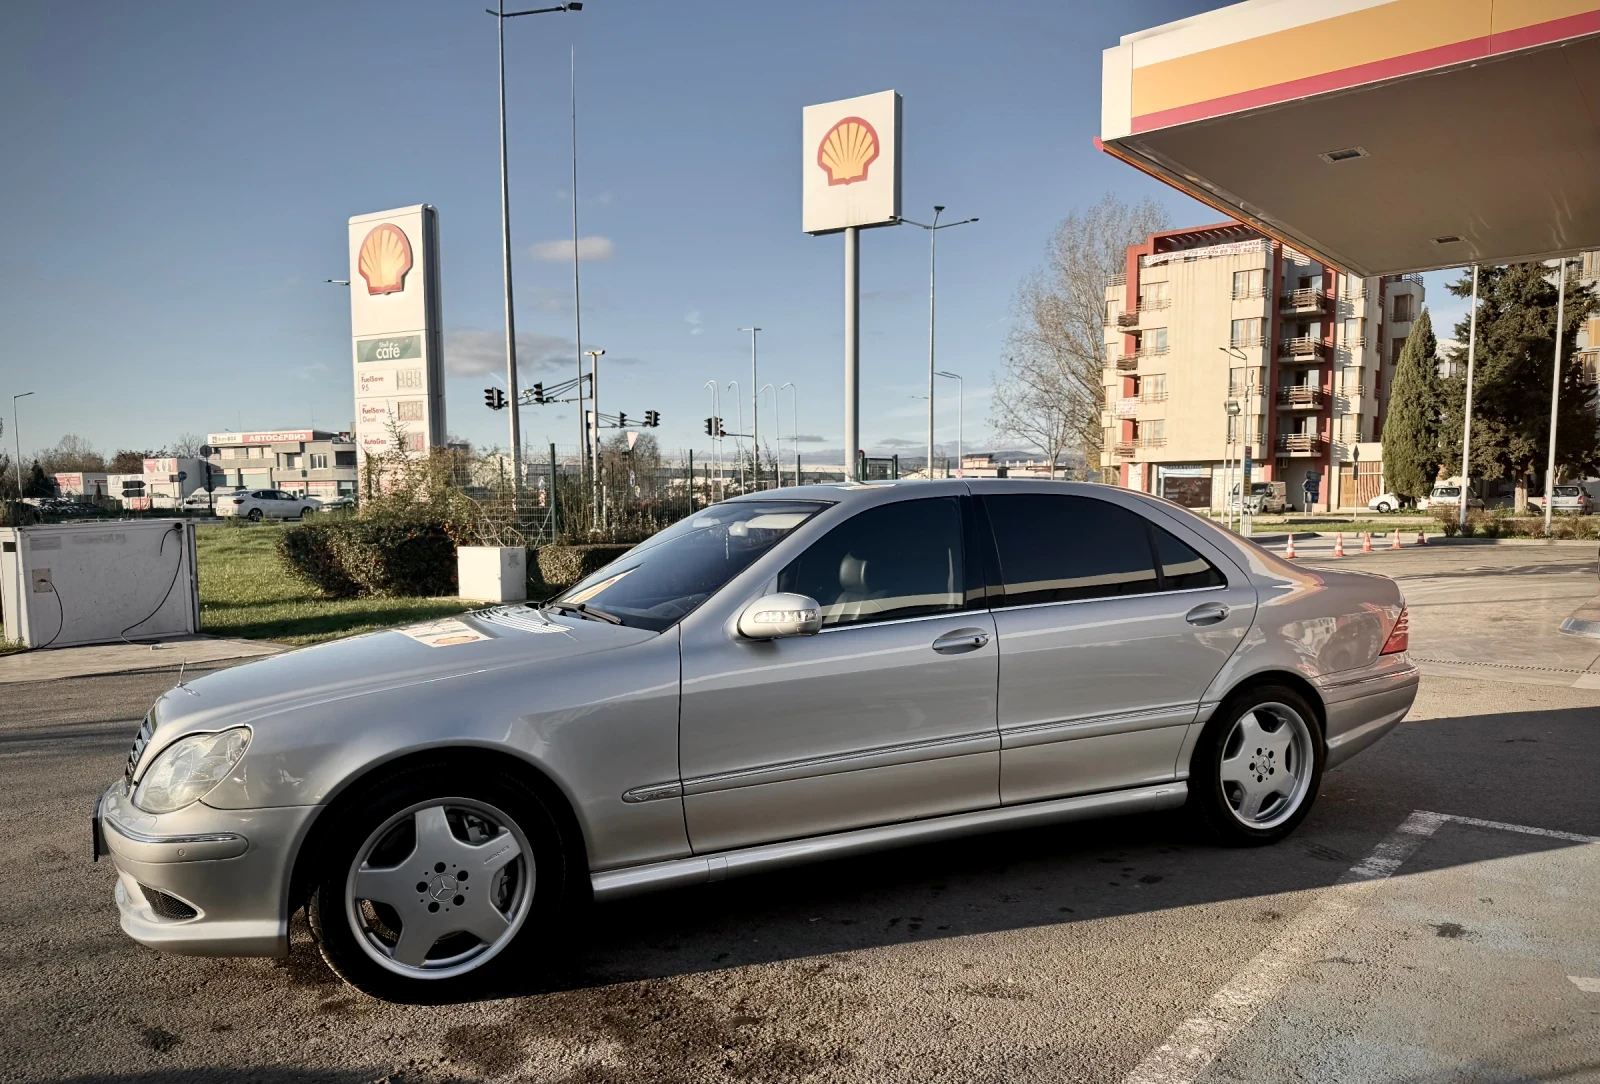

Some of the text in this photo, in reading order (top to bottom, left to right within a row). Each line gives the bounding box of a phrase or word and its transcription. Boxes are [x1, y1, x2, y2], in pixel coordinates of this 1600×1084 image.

[376, 343, 400, 359] café
[362, 407, 386, 415] FuelSave
[249, 434, 306, 442] АВТОСЕРВИЗ
